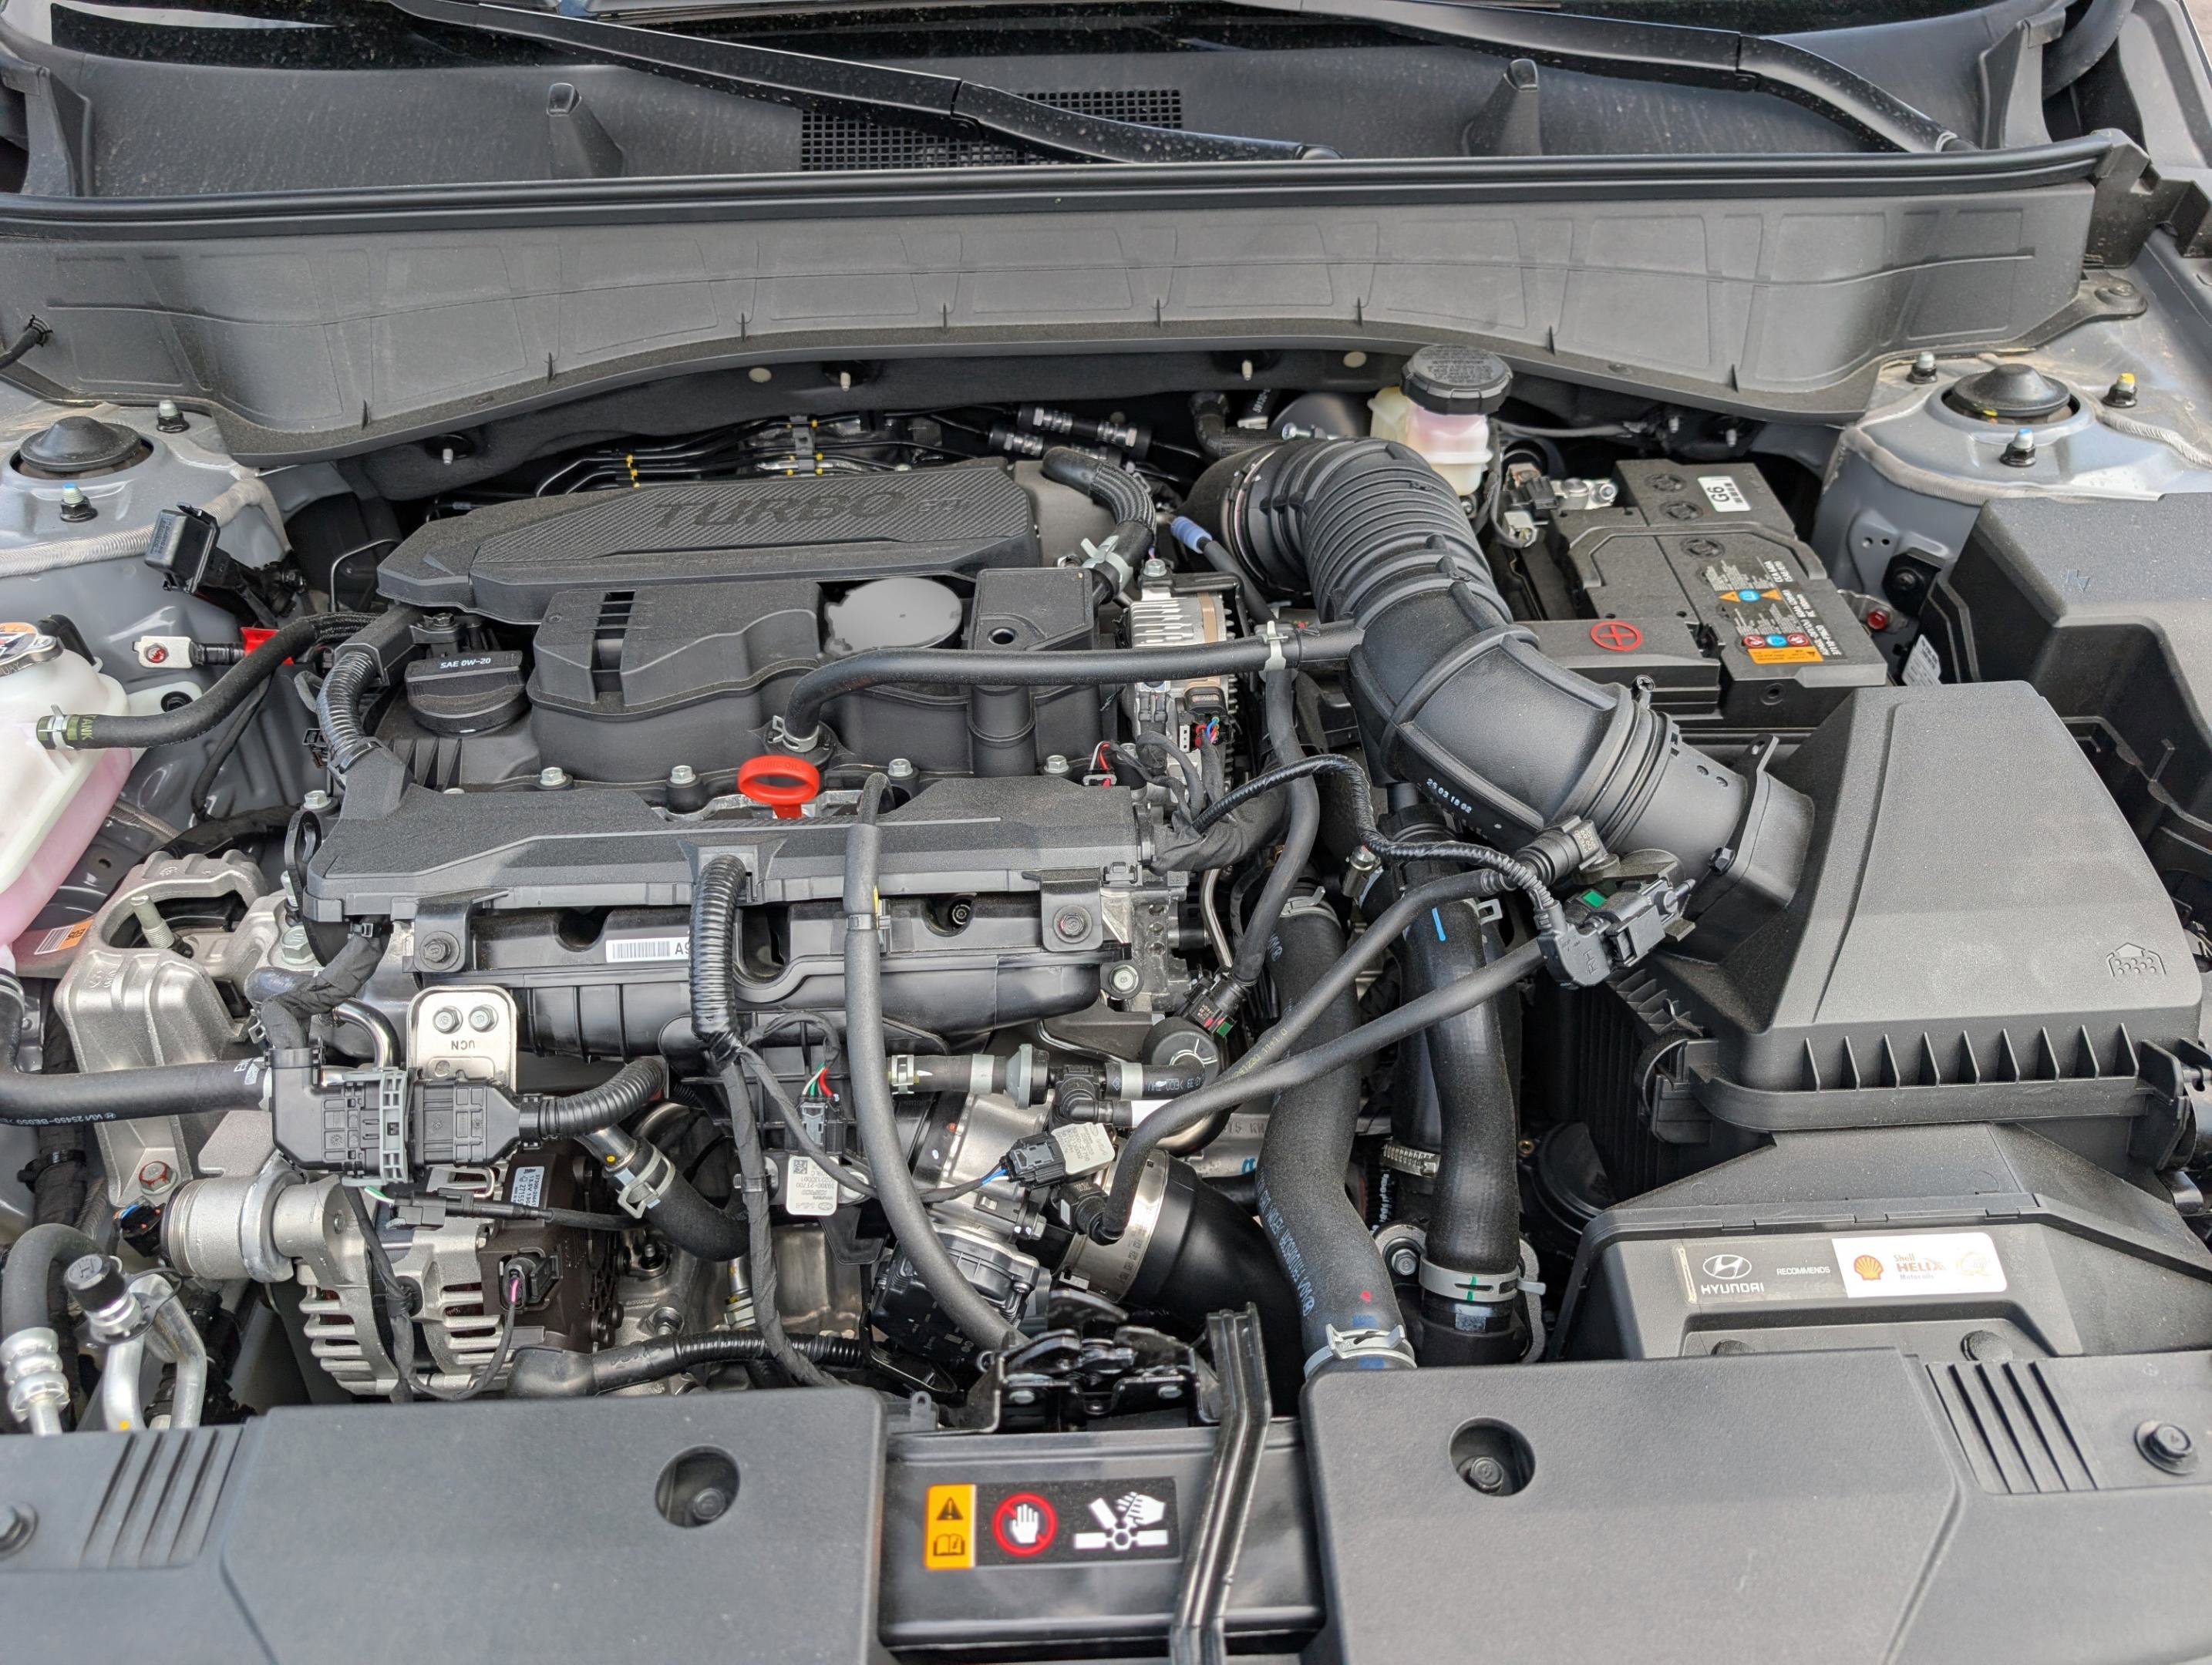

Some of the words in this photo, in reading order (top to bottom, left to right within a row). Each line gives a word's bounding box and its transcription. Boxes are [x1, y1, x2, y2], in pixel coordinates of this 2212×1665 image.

[1706, 486, 1729, 503] G6
[653, 490, 904, 529] TURBO
[440, 661, 459, 669] SAE
[461, 658, 491, 666] 0W-20
[81, 715, 99, 741] TANK
[451, 1041, 475, 1050] UCN
[1894, 1253, 1916, 1262] Shell
[1701, 1282, 1765, 1294] HYUNDAI
[1776, 1266, 1830, 1276] RECOMMENDS
